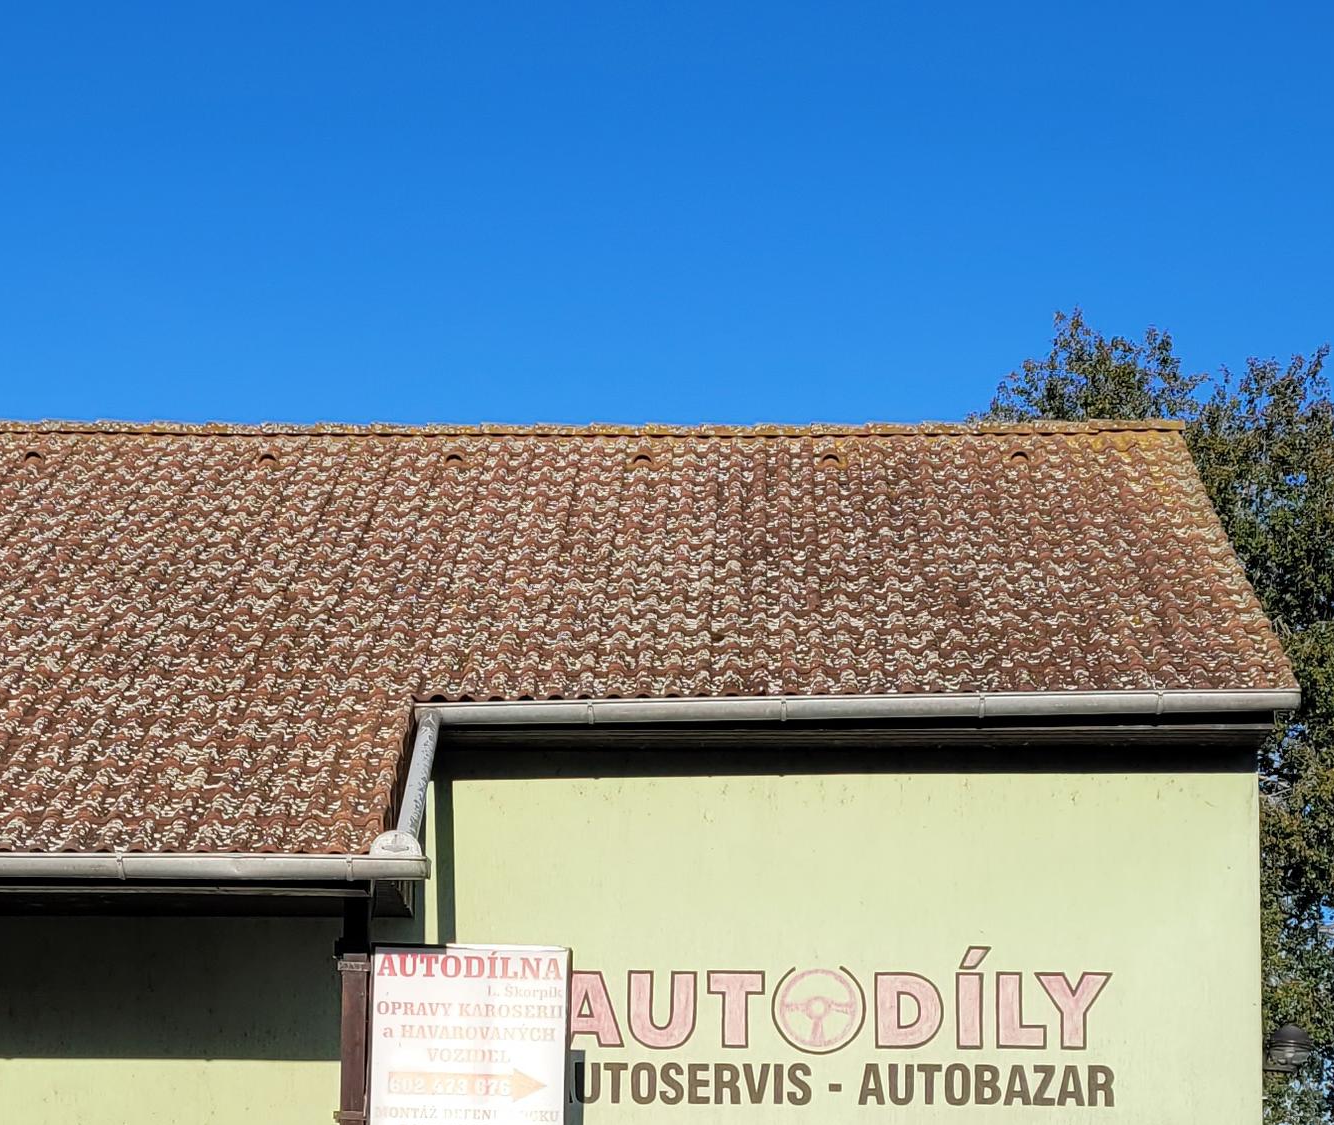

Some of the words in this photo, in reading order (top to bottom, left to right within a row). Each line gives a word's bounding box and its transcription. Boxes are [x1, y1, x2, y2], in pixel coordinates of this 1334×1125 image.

[376, 951, 563, 980] AUTODÍLNA
[376, 1000, 454, 1017] OPRAVY
[383, 1027, 394, 1038] a
[400, 1023, 556, 1041] HAVAROVANÝCH
[427, 1048, 511, 1063] VOZIDEL
[569, 1061, 812, 1106] UTOSERVIS
[858, 1062, 1116, 1107] AUTOBAZAR
